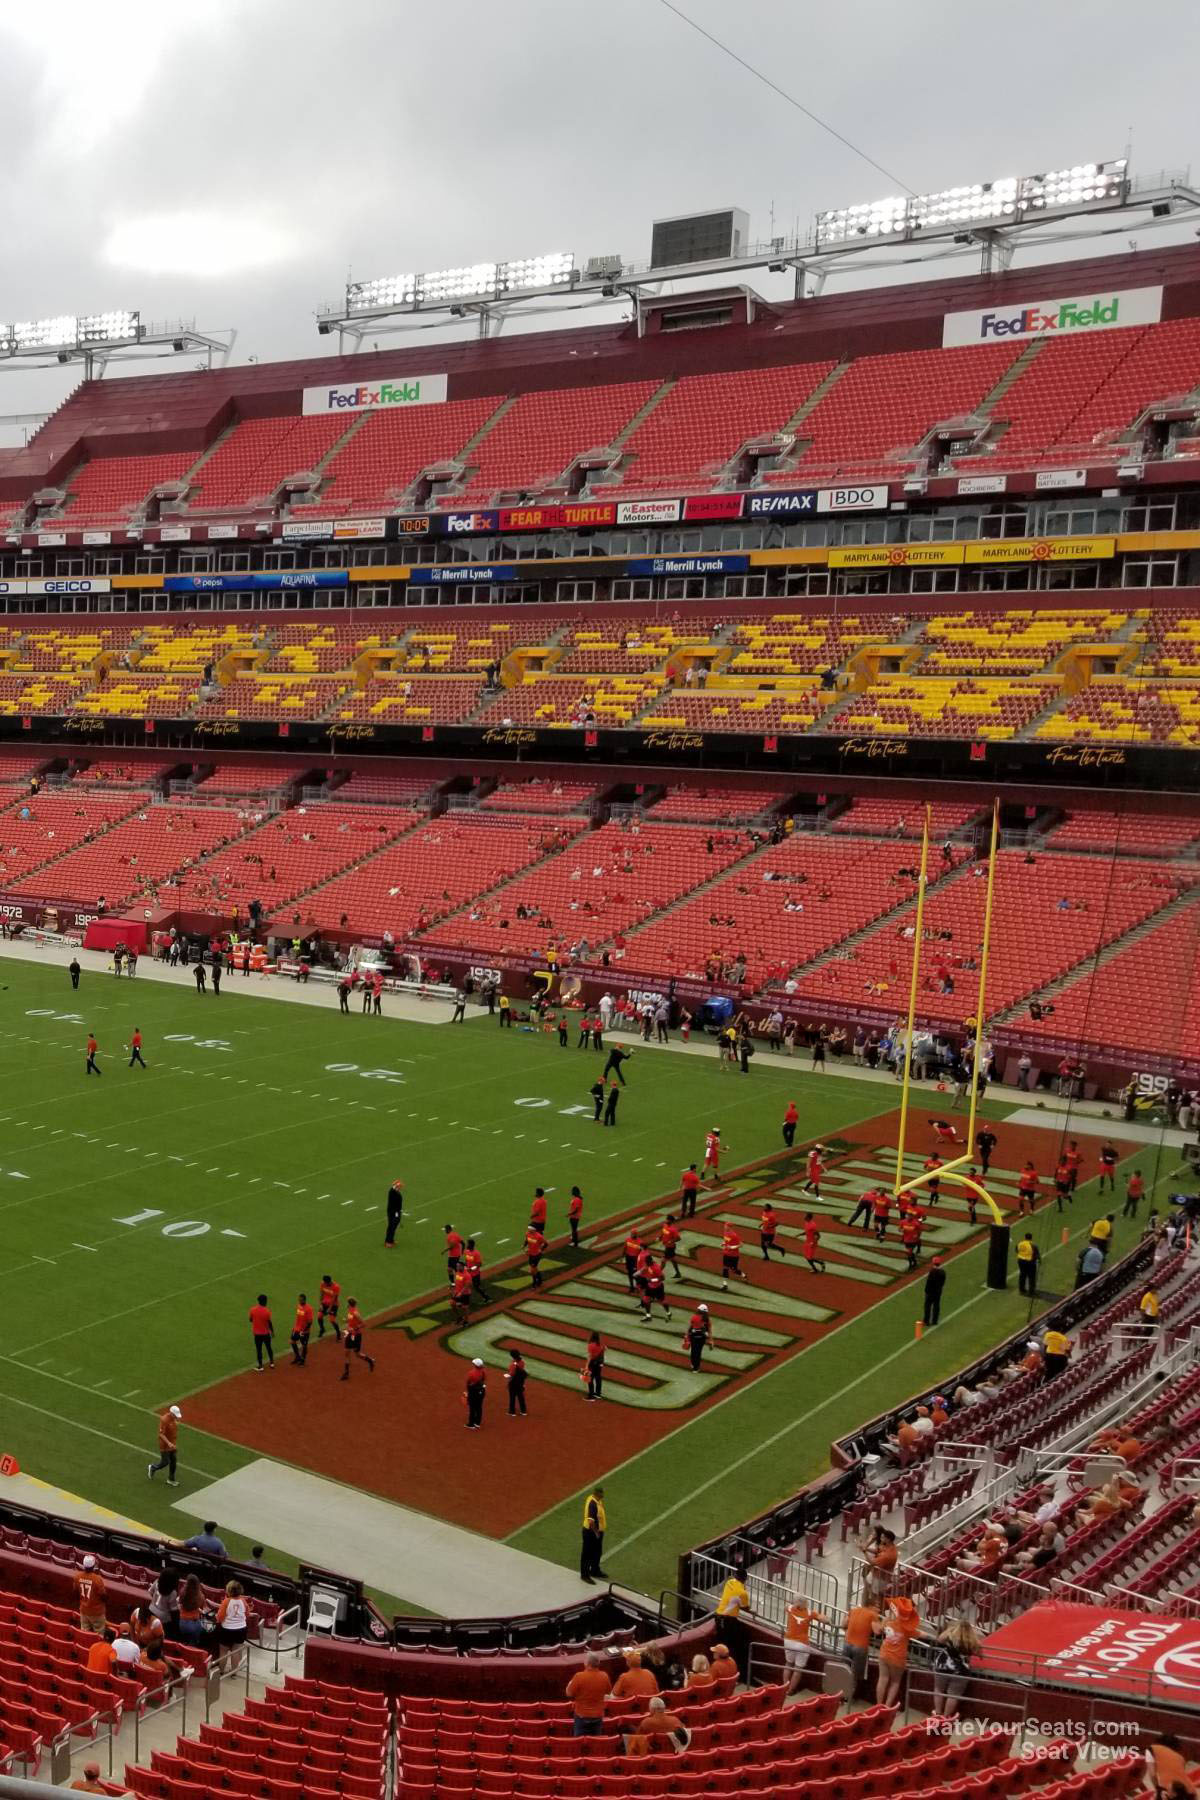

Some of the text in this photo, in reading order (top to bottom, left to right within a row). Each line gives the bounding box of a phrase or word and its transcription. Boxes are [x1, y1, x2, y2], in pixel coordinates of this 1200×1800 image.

[980, 298, 1119, 338] FedExField
[328, 382, 420, 409] FedExField
[751, 495, 812, 512] RE/MAX
[834, 488, 874, 505] BDO
[631, 503, 676, 514] Eastern
[447, 514, 491, 532] FedEx
[844, 550, 945, 563] MARYLAND LOTTERY
[983, 545, 1093, 557] MARYLAND LOTTERY
[665, 560, 694, 571] Merrill
[696, 559, 723, 572] Lynch
[281, 573, 318, 587] AQUAFINA
[442, 569, 467, 580] Merrill
[469, 568, 493, 580] Lynch
[44, 581, 91, 592] GEICO
[202, 578, 223, 587] pepsi
[112, 1207, 211, 1238] 10
[1, 1457, 12, 1473] G
[80, 1583, 93, 1600] 17
